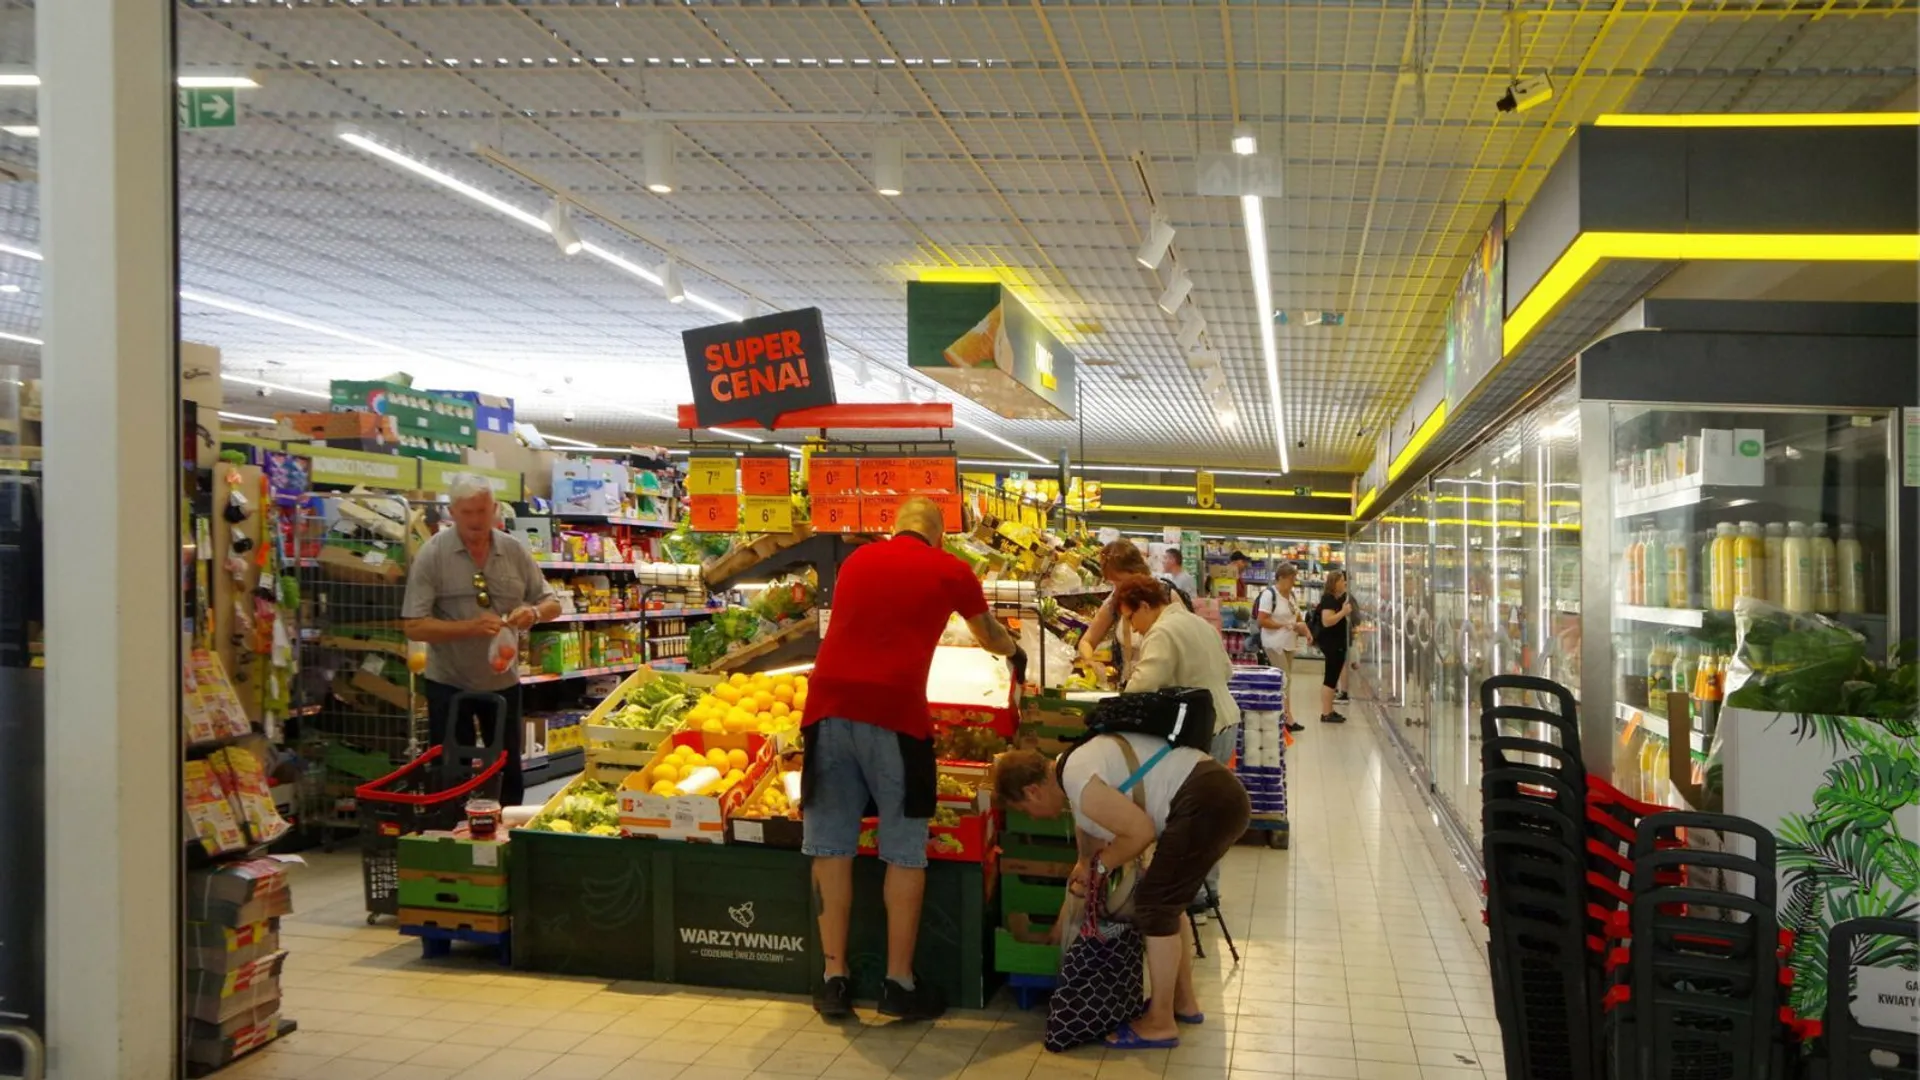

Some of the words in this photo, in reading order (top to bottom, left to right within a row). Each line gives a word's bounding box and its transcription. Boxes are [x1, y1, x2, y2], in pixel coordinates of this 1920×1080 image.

[705, 329, 805, 372] SUPER
[711, 358, 810, 402] CENA!
[679, 927, 804, 952] WARZYWNIAK
[1878, 992, 1917, 1007] KWIATY
